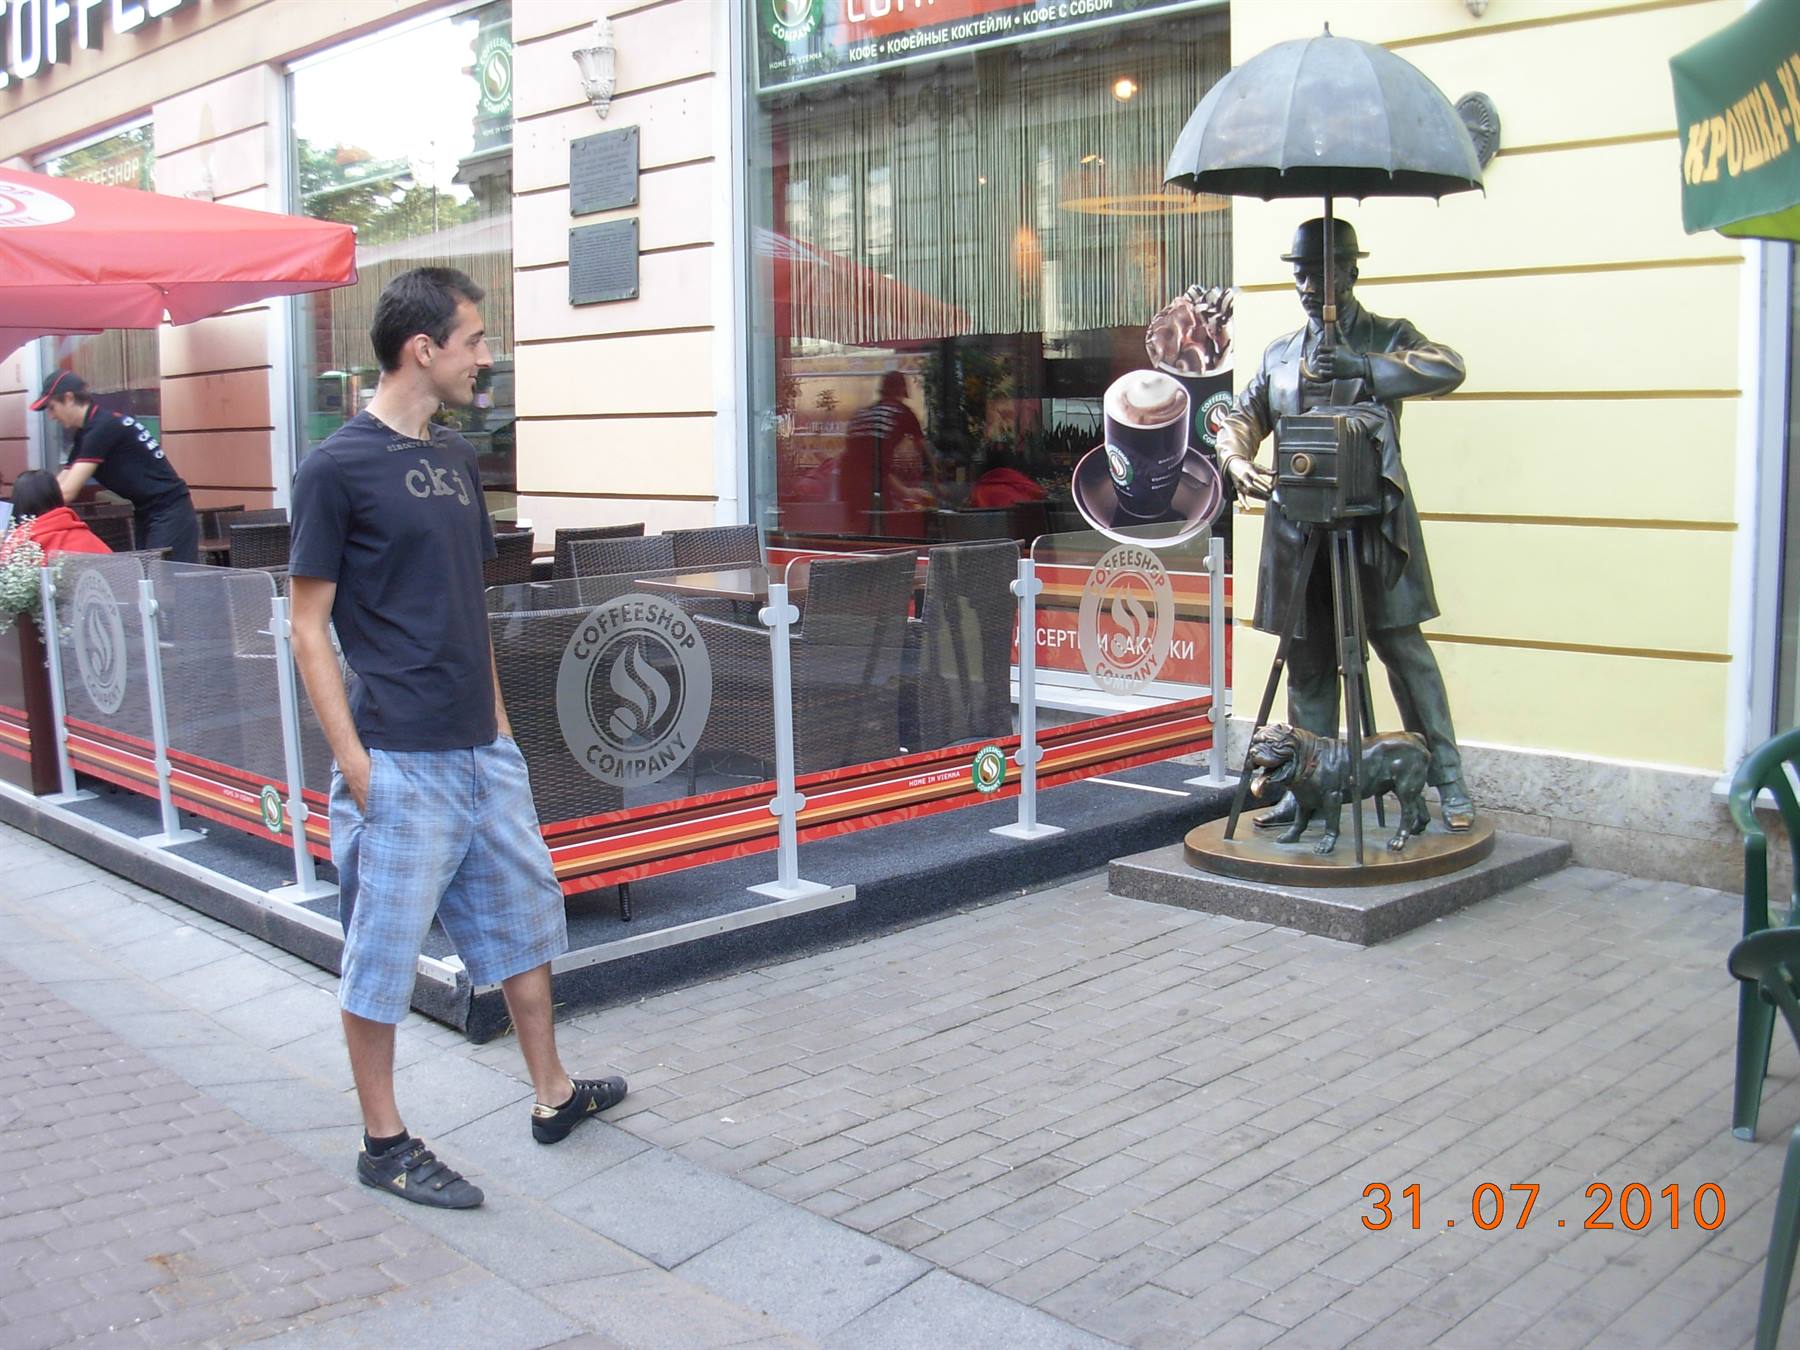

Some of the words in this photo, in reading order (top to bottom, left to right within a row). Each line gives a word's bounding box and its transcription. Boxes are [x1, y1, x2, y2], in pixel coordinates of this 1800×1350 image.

[772, 16, 816, 41] COMPANY
[850, 46, 878, 62] КОФЕ
[887, 27, 948, 54] КОФЕЙНЫЕ
[951, 14, 1012, 40] КОКТЕЙЛИ
[1023, 4, 1057, 26] КОФЕ
[1058, 4, 1067, 18] С
[574, 602, 696, 660] COFFEESHOP
[586, 731, 686, 779] COMPANY
[908, 777, 926, 788] HOME
[927, 776, 936, 784] IN
[937, 771, 961, 782] VIENNA
